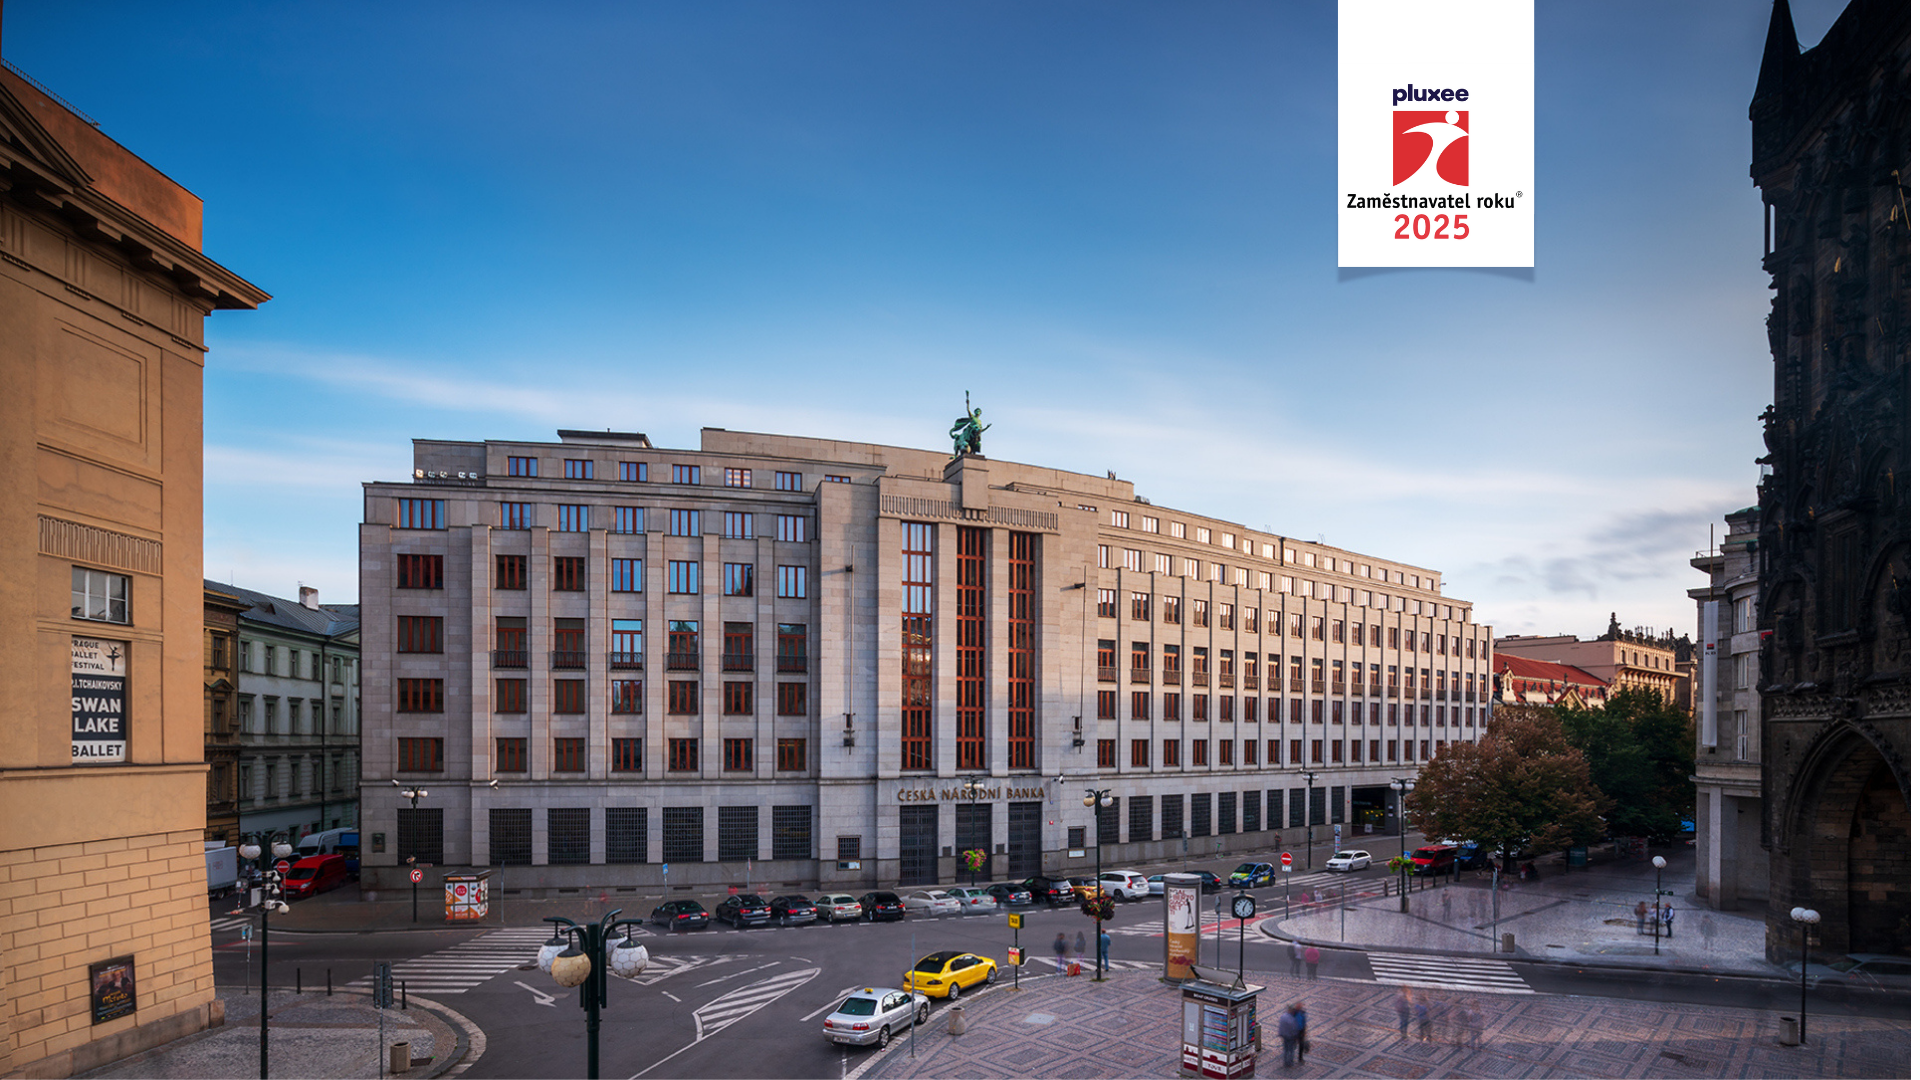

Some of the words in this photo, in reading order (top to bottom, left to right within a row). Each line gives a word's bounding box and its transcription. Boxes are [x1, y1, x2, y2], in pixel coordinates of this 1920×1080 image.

[72, 639, 99, 649] RAGUE
[72, 697, 121, 712] SWAN
[74, 718, 119, 732] LAKE
[72, 744, 122, 757] BALLET
[897, 788, 936, 801] ČESKÁ
[1006, 787, 1045, 799] BANKA
